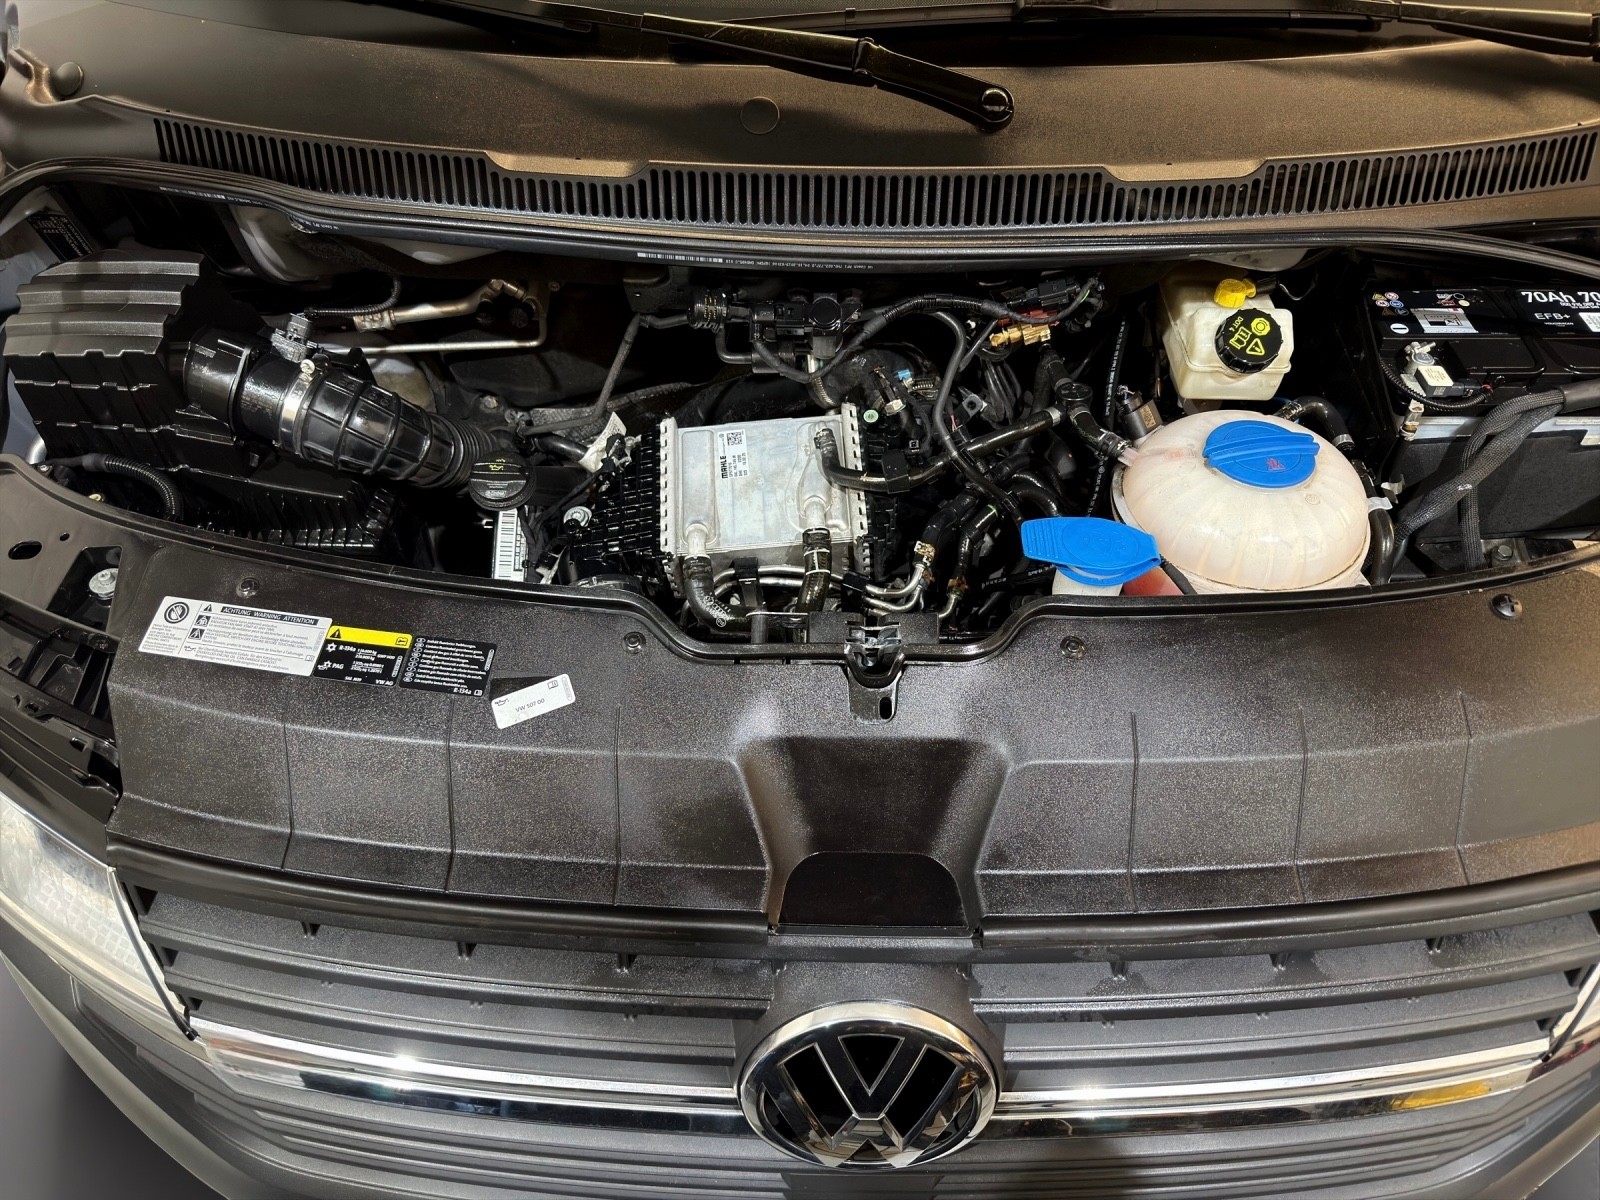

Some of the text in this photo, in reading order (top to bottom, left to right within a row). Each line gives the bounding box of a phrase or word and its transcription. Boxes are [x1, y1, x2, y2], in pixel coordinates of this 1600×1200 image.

[1521, 291, 1576, 303] 70Ah
[1232, 316, 1244, 329] DOT
[1534, 312, 1571, 320] EFB+
[720, 455, 729, 479] MAHLE
[223, 607, 251, 616] ACHTUNG
[253, 611, 281, 620] WARNING
[283, 615, 315, 625] ATTENTION
[515, 705, 526, 713] VW
[526, 701, 537, 709] 507
[752, 1016, 988, 1168] VW
